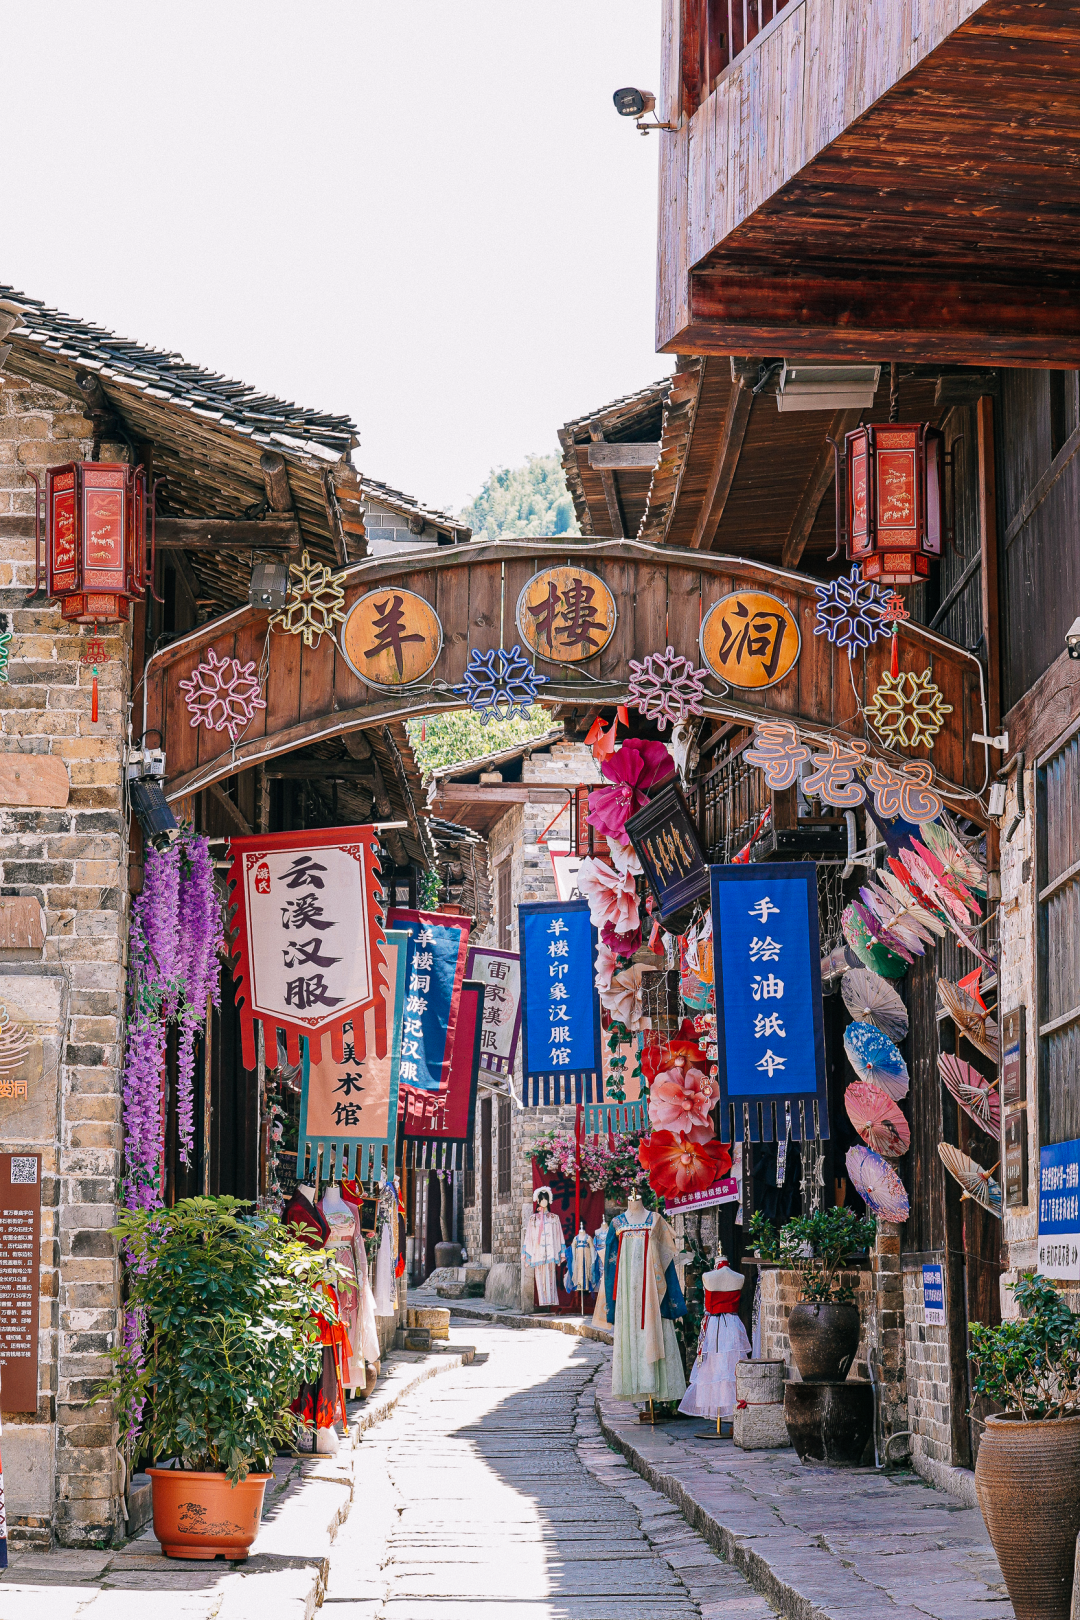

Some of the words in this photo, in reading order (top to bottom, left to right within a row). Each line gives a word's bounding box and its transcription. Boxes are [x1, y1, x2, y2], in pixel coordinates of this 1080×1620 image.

[256, 867, 271, 893] 游氏
[277, 856, 345, 1010] 云溪汉服
[399, 930, 437, 1082] 羊楼洞游记汉服
[481, 960, 510, 1050] 雷家漢服
[546, 918, 572, 1066] 羊楼印象汉服馆
[748, 896, 787, 1078] 手绘油纸伞
